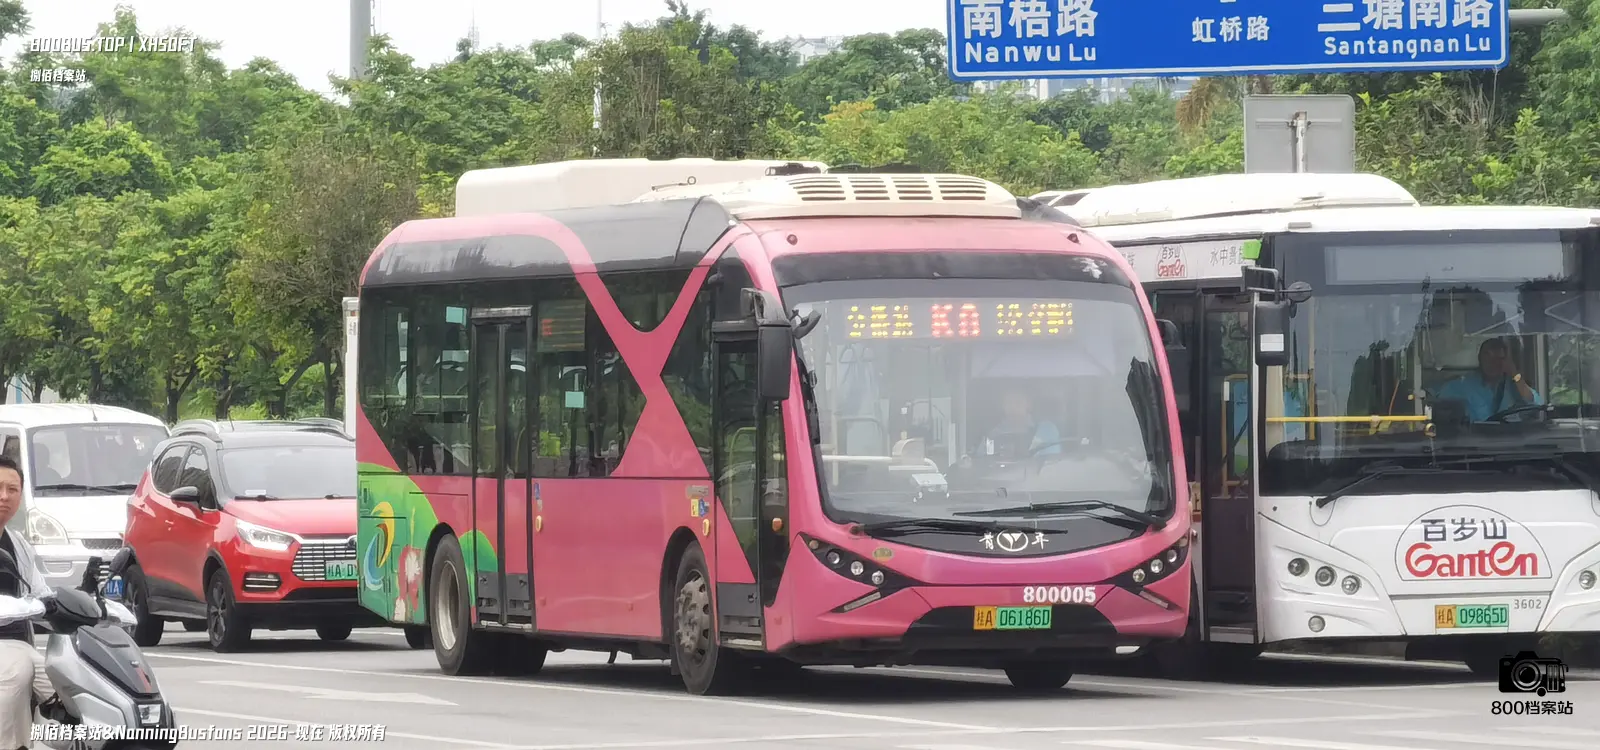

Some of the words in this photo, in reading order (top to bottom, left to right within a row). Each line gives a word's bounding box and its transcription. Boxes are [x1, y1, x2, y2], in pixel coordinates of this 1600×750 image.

[963, 0, 1099, 39] 南梧路
[1192, 15, 1270, 43] 虹桥路
[965, 42, 1061, 63] Nanwu
[1069, 43, 1097, 62] Lu
[1324, 36, 1459, 59] Santangnan
[1465, 36, 1491, 53] Lu
[1421, 518, 1508, 542] 百岁山
[1023, 586, 1096, 603] 800005
[1514, 599, 1542, 610] 3602
[1000, 609, 1050, 626] 06186D
